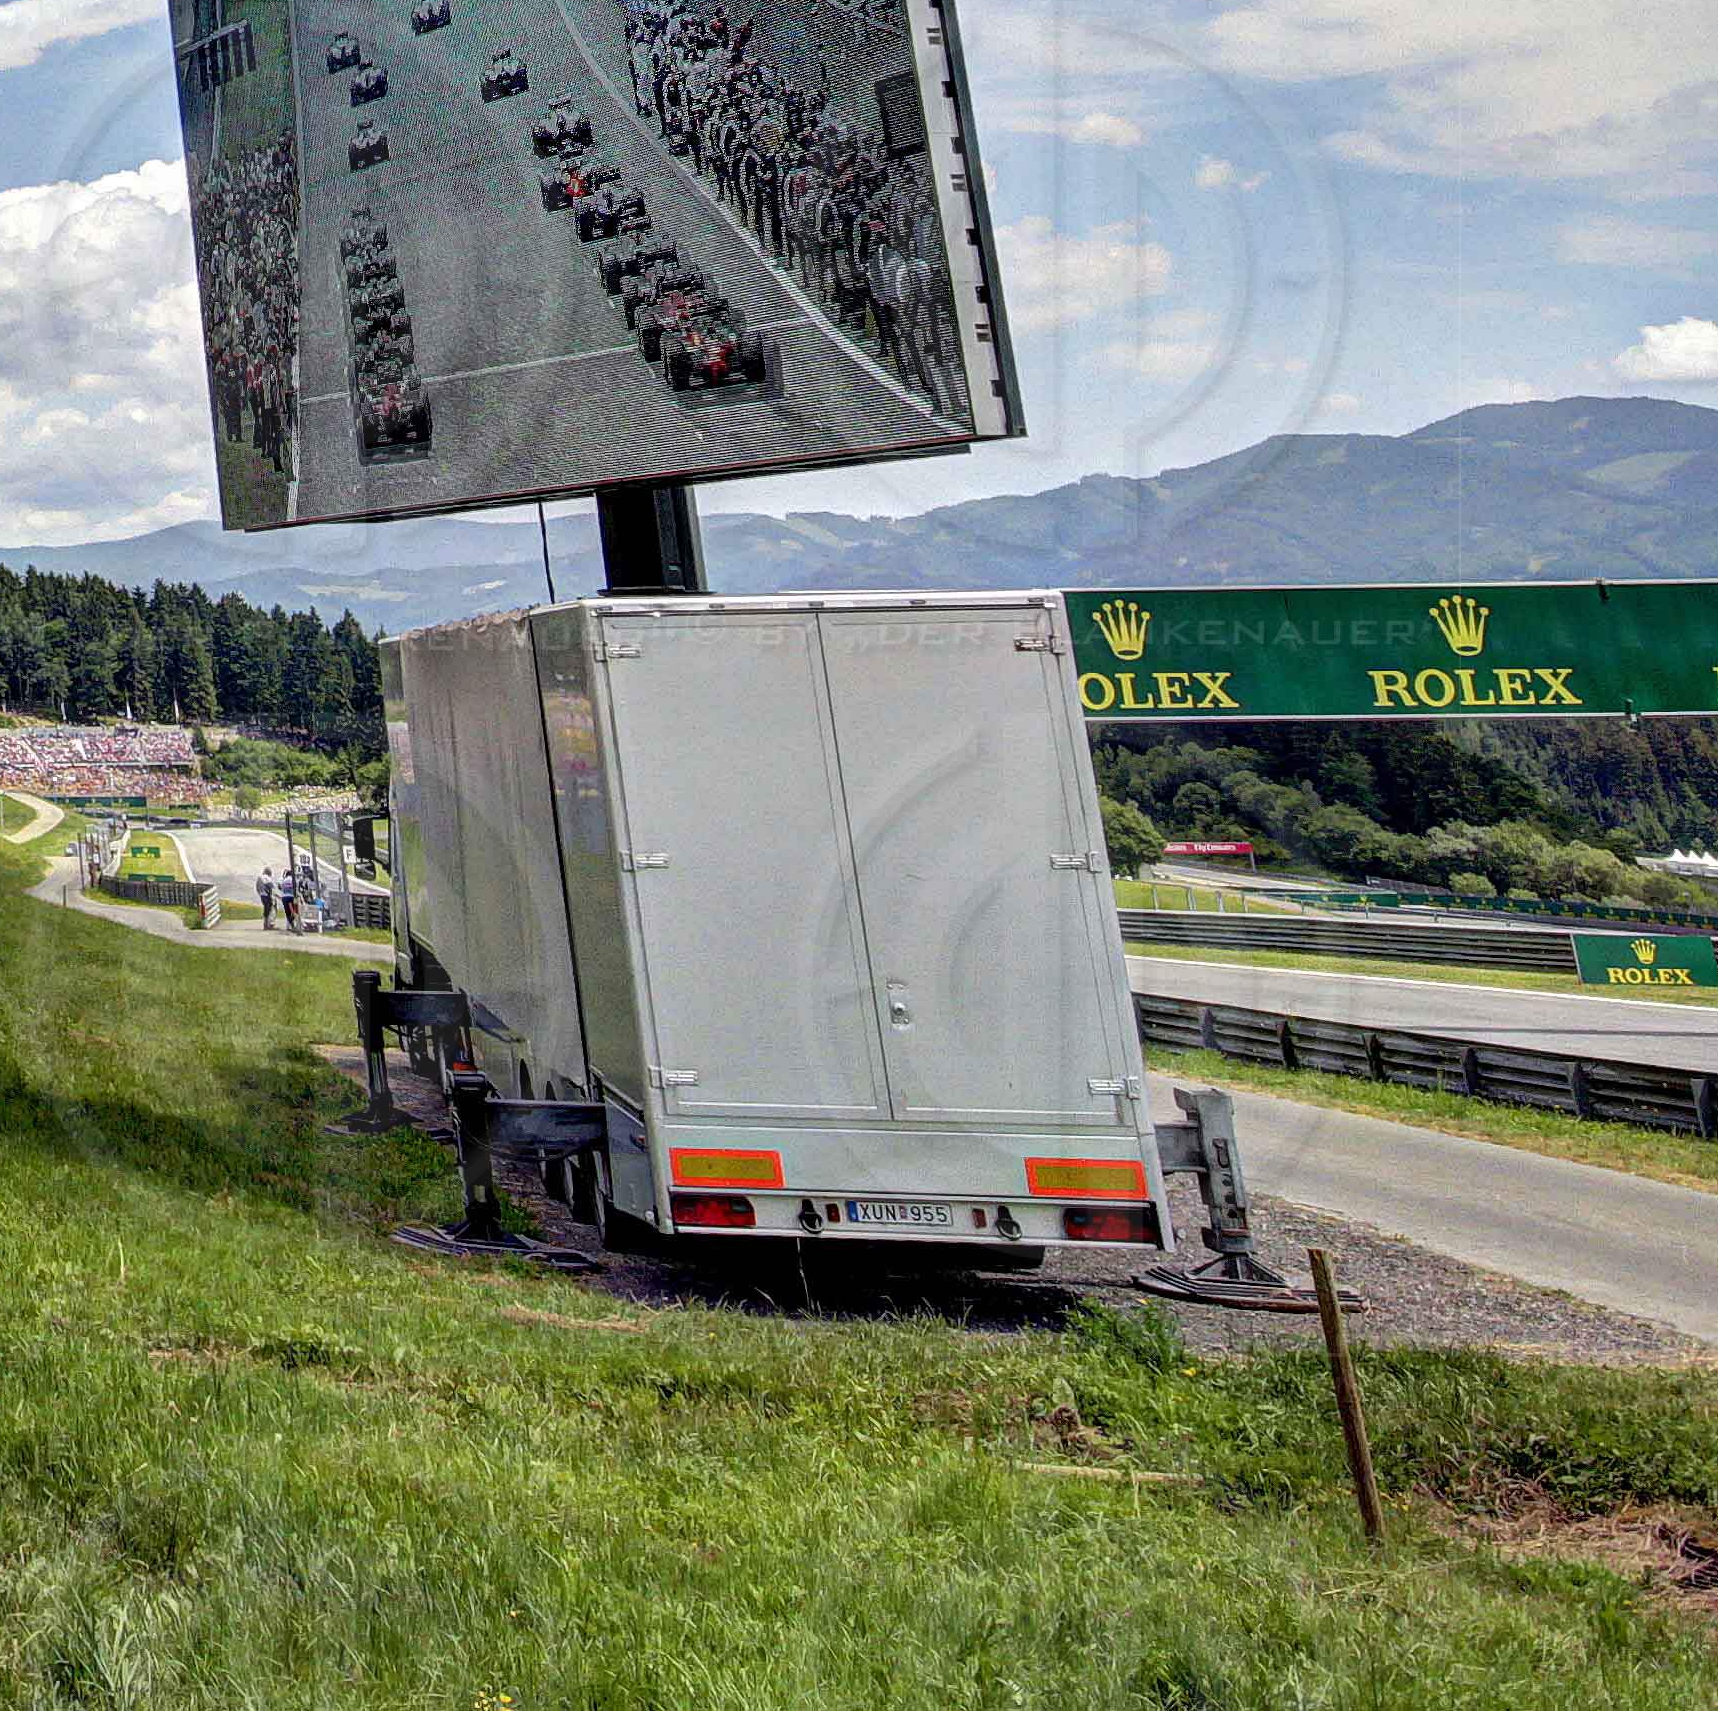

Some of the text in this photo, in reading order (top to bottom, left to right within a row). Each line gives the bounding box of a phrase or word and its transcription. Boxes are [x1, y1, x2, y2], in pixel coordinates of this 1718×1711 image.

[1077, 672, 1240, 710] OLEX
[1366, 668, 1583, 707] ROLEX
[1607, 968, 1694, 985] ROLEX
[860, 1203, 947, 1223] XUN 955
